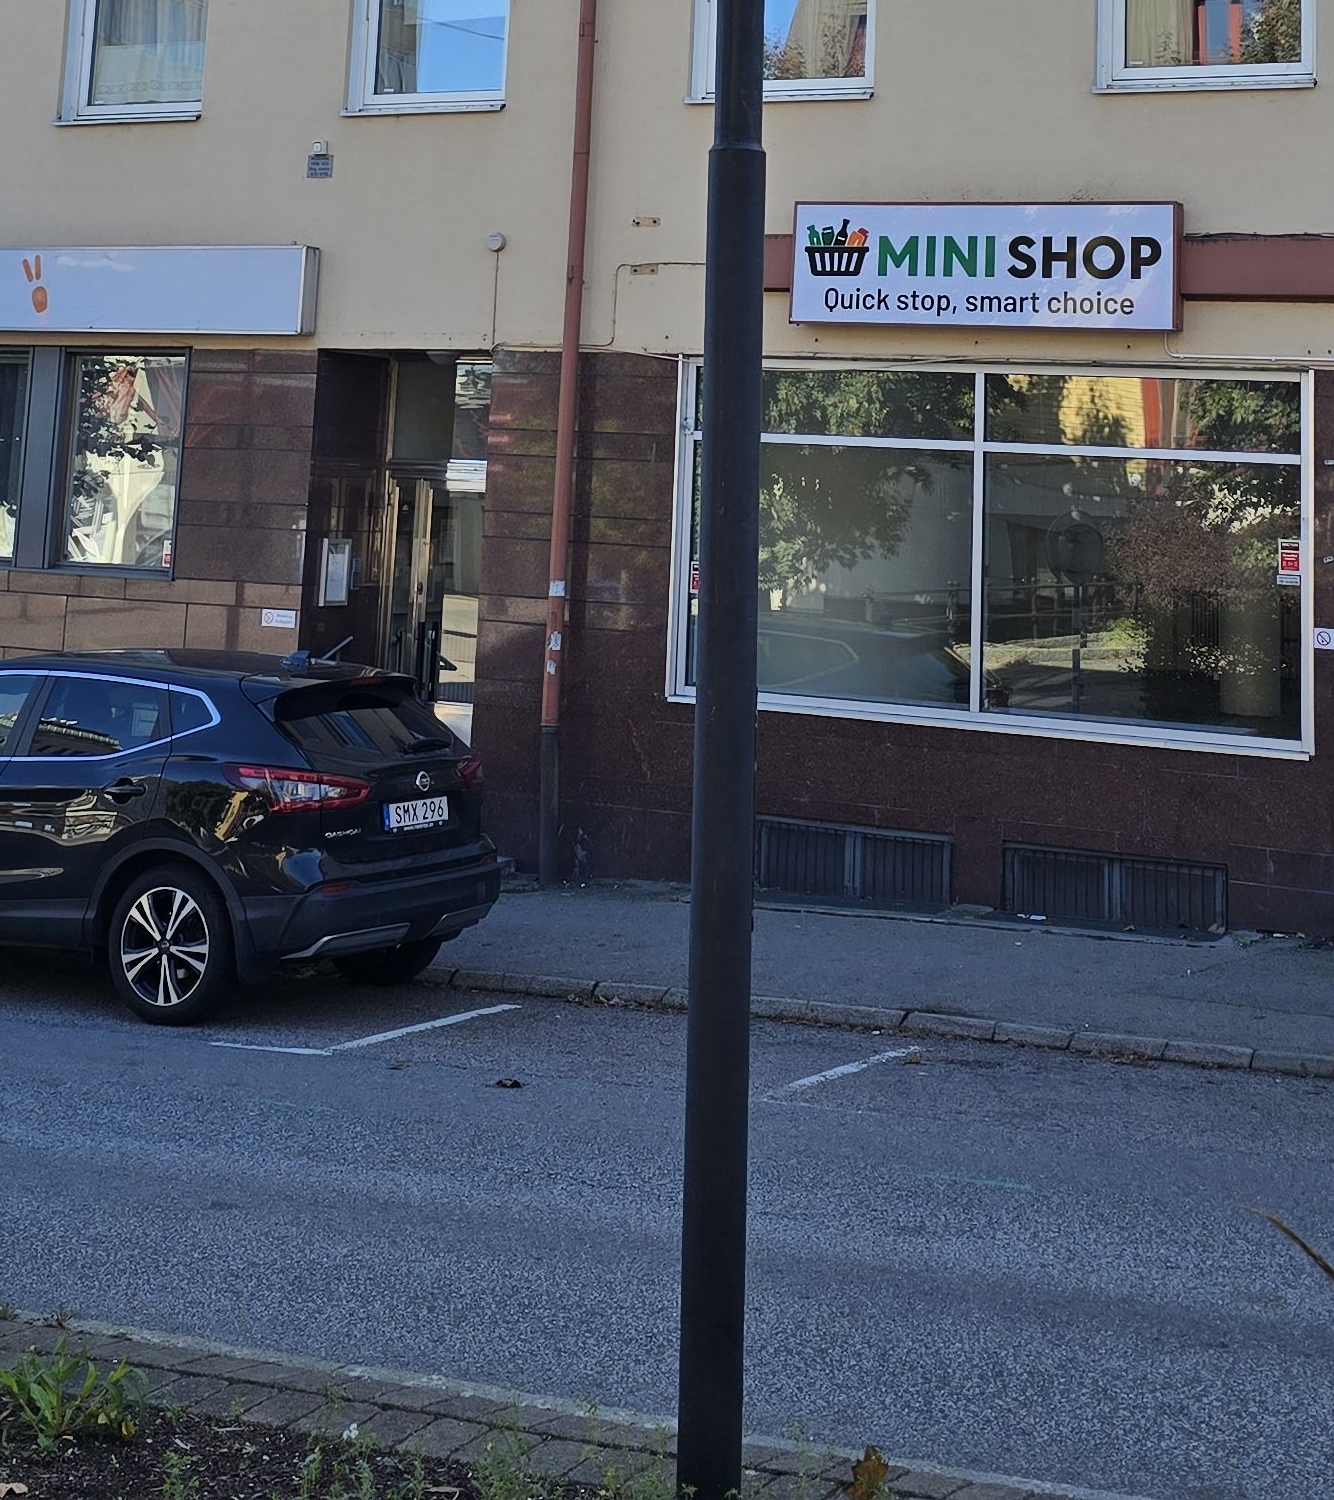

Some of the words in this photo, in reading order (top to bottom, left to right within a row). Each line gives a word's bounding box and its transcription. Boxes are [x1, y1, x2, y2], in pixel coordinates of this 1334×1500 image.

[877, 235, 996, 278] MINI
[1007, 235, 1162, 280] SHOP
[824, 287, 890, 312] Quick
[896, 290, 957, 317] stop,
[965, 292, 1040, 314] smart
[1047, 291, 1135, 315] choice
[395, 803, 419, 824] SMX
[422, 799, 444, 820] 296
